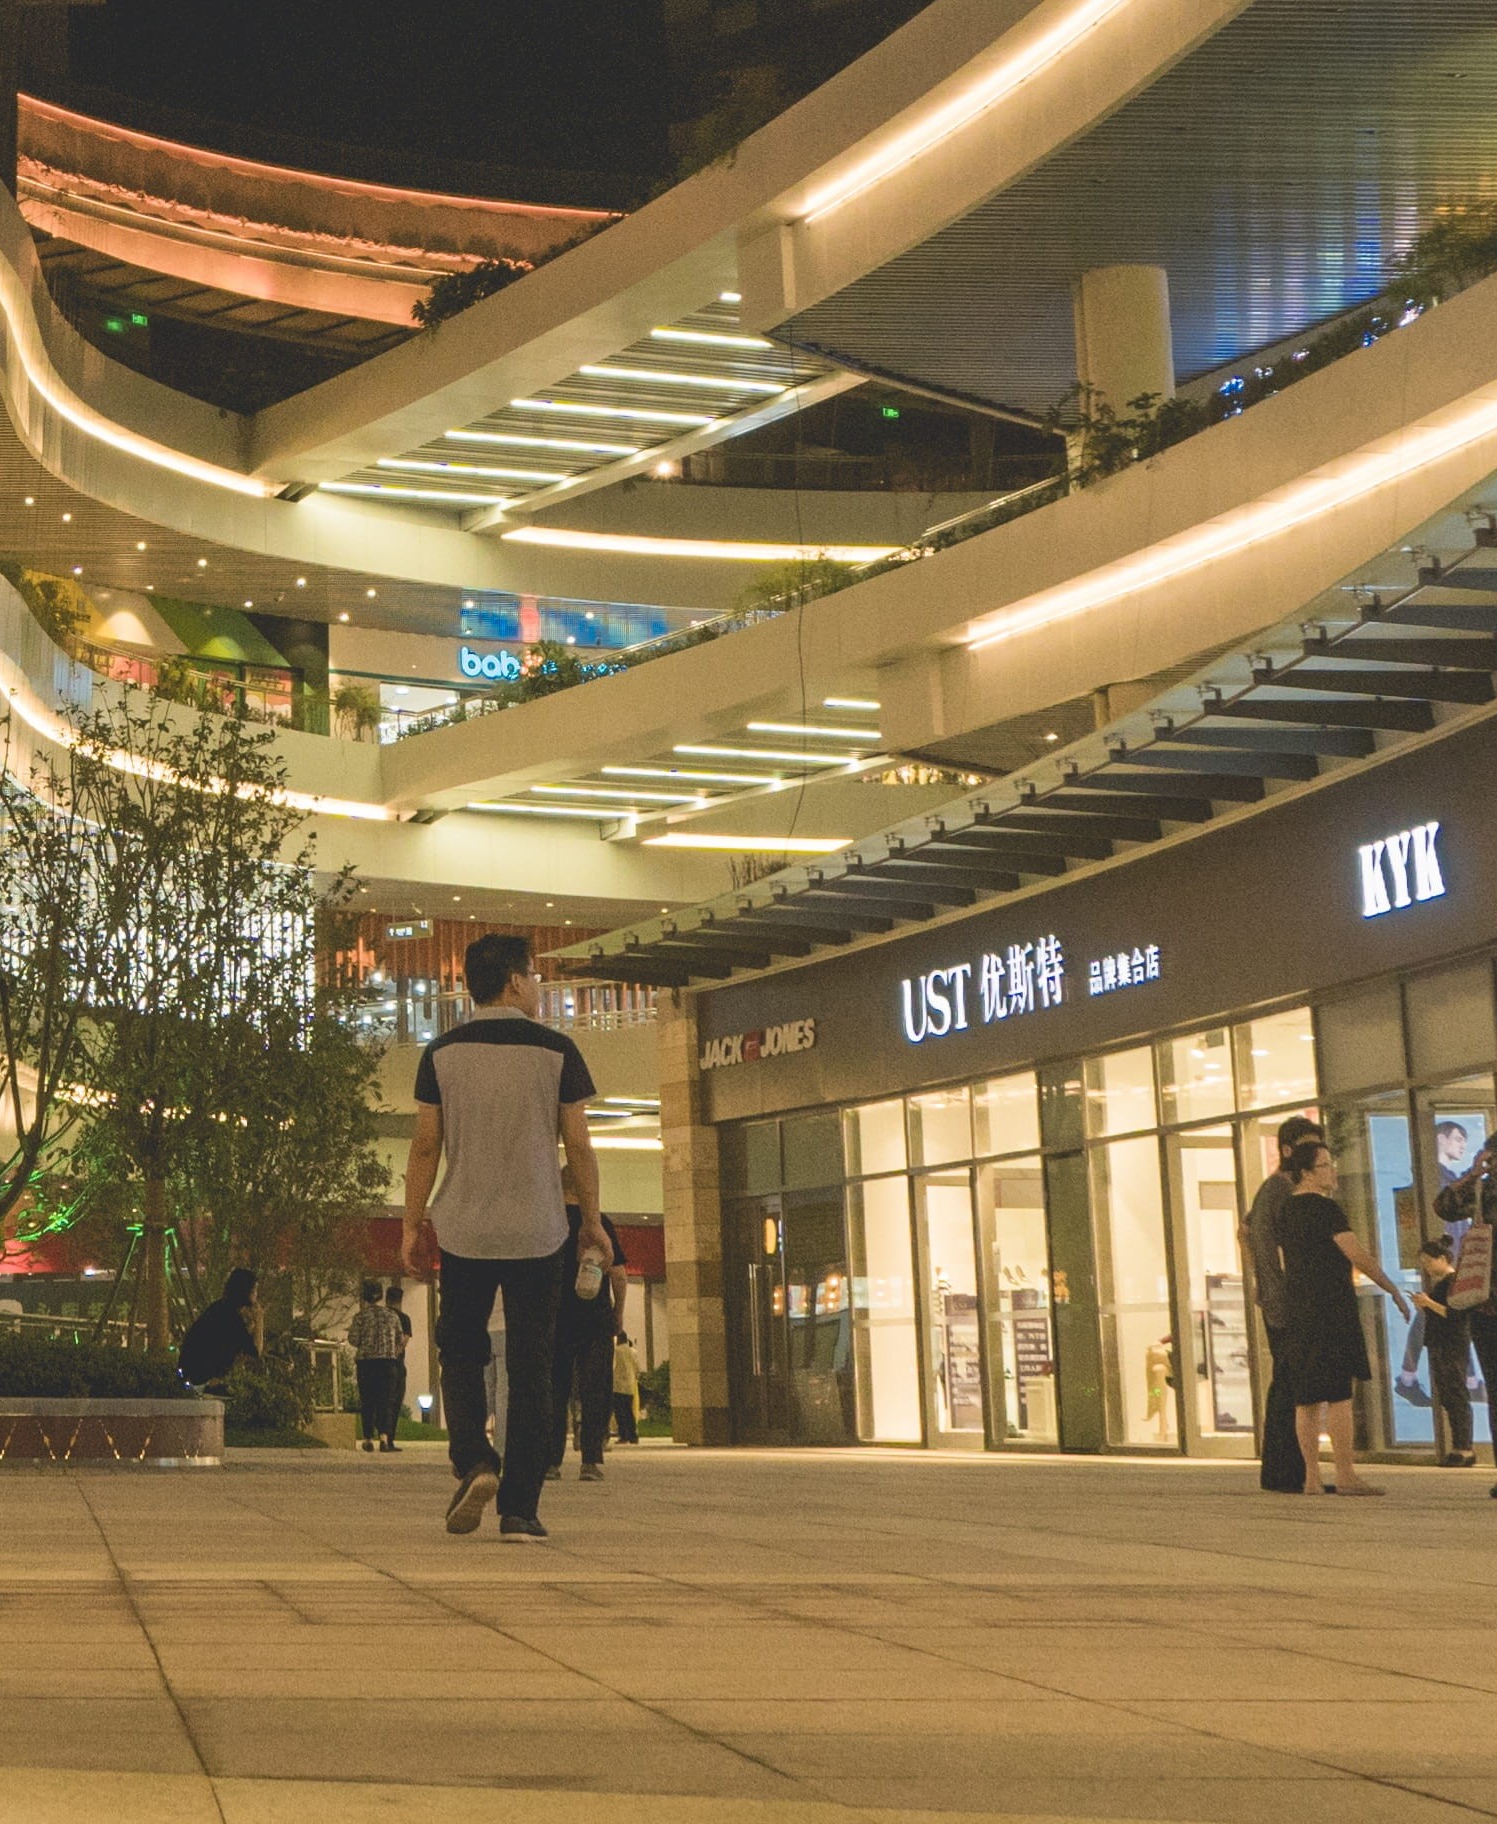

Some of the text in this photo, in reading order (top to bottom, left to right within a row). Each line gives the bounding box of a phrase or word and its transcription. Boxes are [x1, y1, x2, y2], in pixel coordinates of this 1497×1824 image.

[1358, 821, 1446, 918] KYK
[902, 934, 1065, 1043] UST 优斯特
[1089, 944, 1161, 996] 品牌集合店
[700, 1034, 744, 1070] JACK
[760, 1018, 815, 1058] JONES
